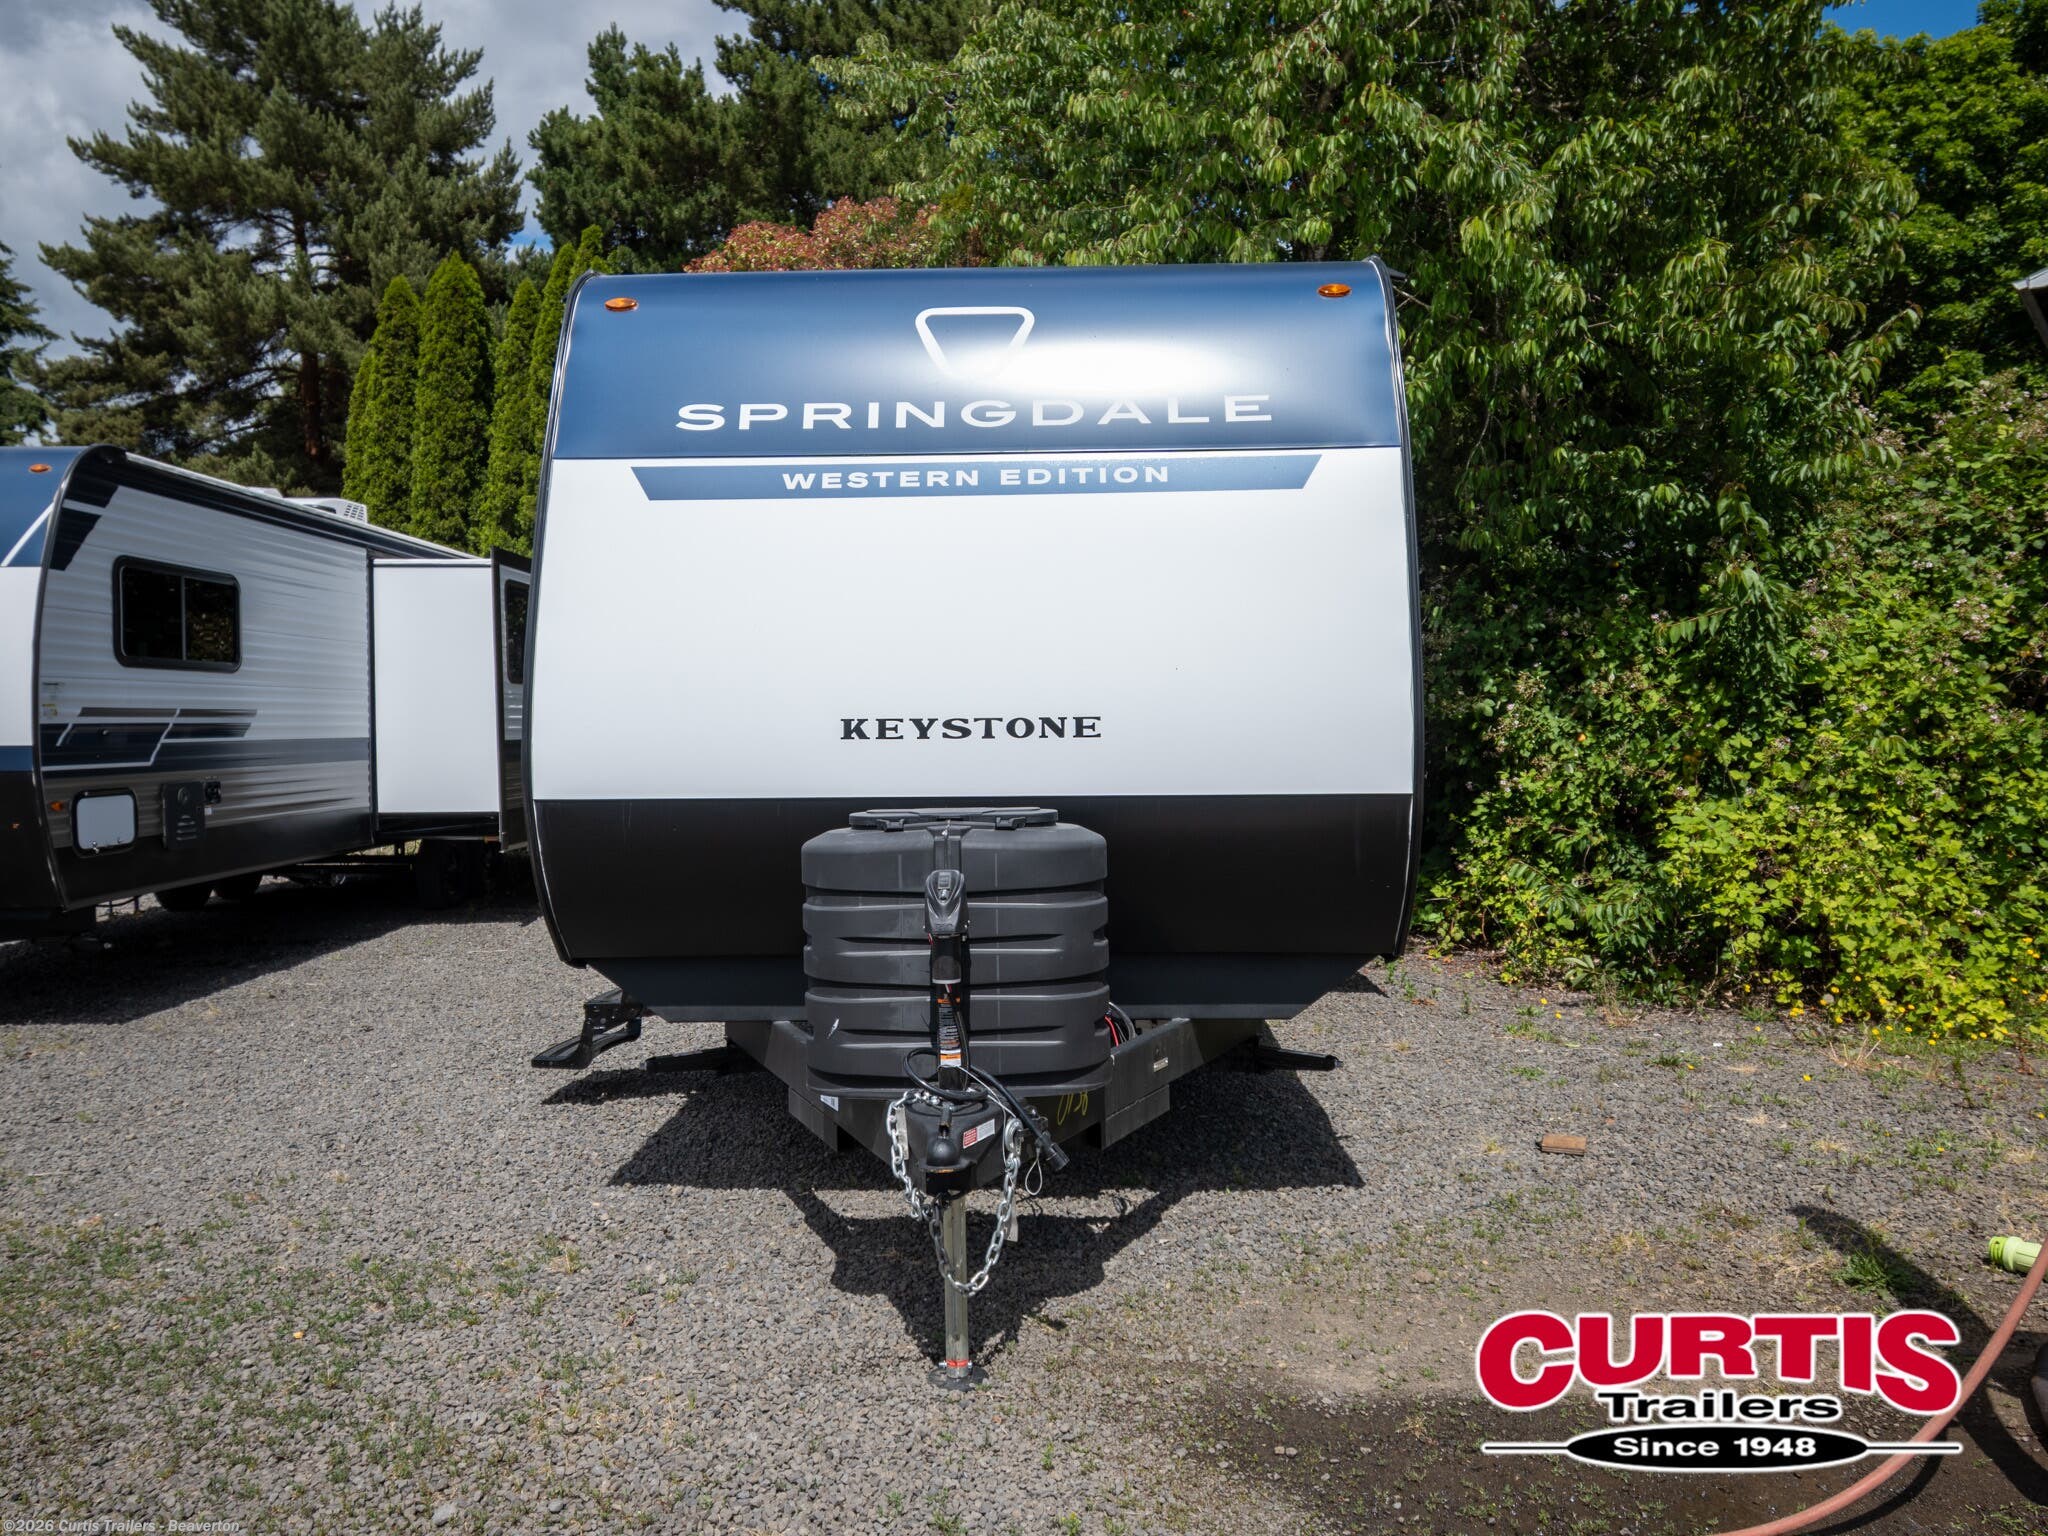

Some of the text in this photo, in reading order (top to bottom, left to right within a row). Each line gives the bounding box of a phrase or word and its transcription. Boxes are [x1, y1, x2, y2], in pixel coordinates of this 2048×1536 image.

[675, 394, 1273, 432] SPRINGDALE
[782, 466, 1169, 491] WESTERN EDITION
[840, 716, 1102, 741] KEYSTONE
